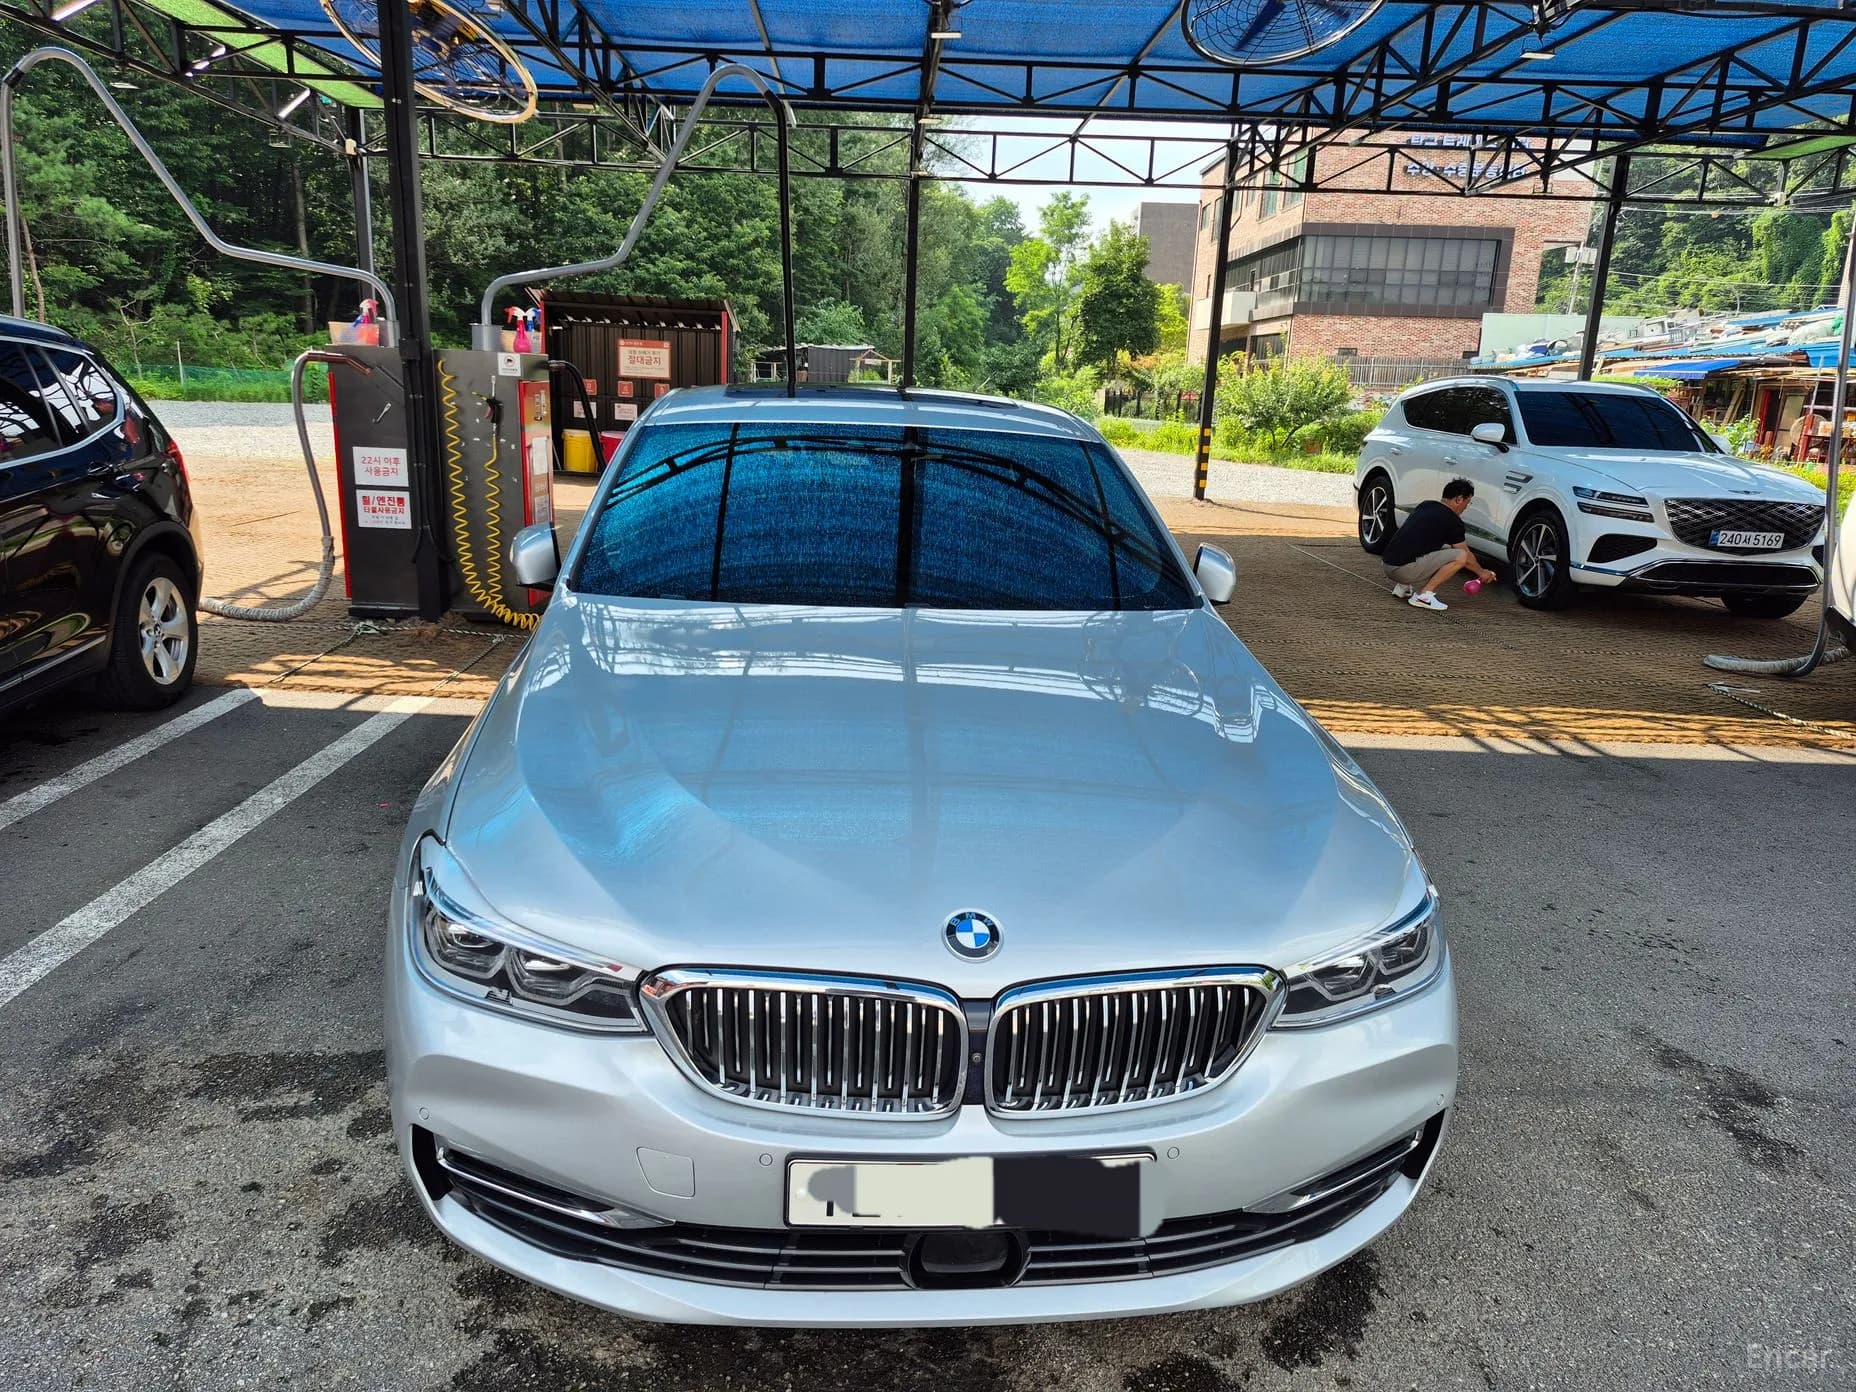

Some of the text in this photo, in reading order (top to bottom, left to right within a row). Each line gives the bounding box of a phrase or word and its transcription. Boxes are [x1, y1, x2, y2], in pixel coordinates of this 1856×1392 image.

[361, 456, 401, 466] 22시 이후
[364, 466, 399, 476] 사용금지
[949, 912, 993, 927] BMW
